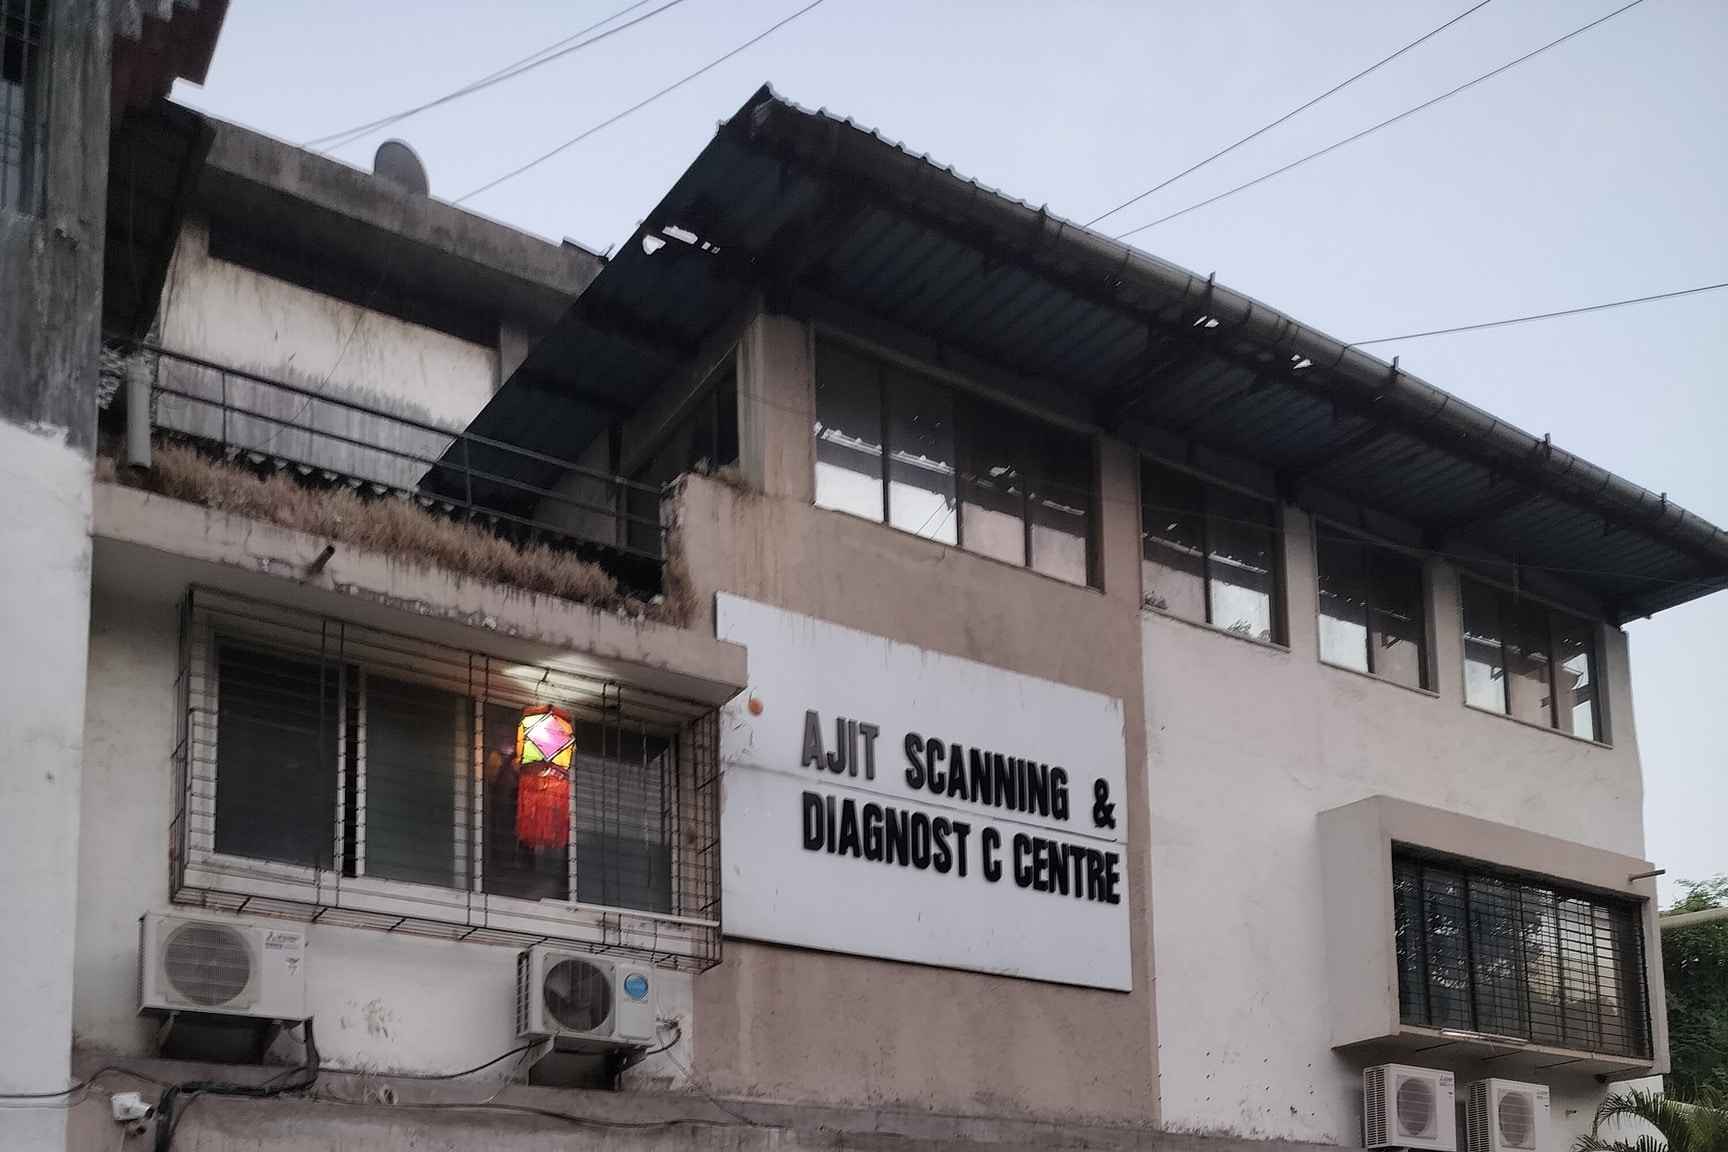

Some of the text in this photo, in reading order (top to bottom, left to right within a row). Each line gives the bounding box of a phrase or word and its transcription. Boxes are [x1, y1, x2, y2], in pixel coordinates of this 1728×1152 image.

[801, 708, 1117, 829] AJIT SCANNING &
[1013, 832, 1121, 905] CENTRE
